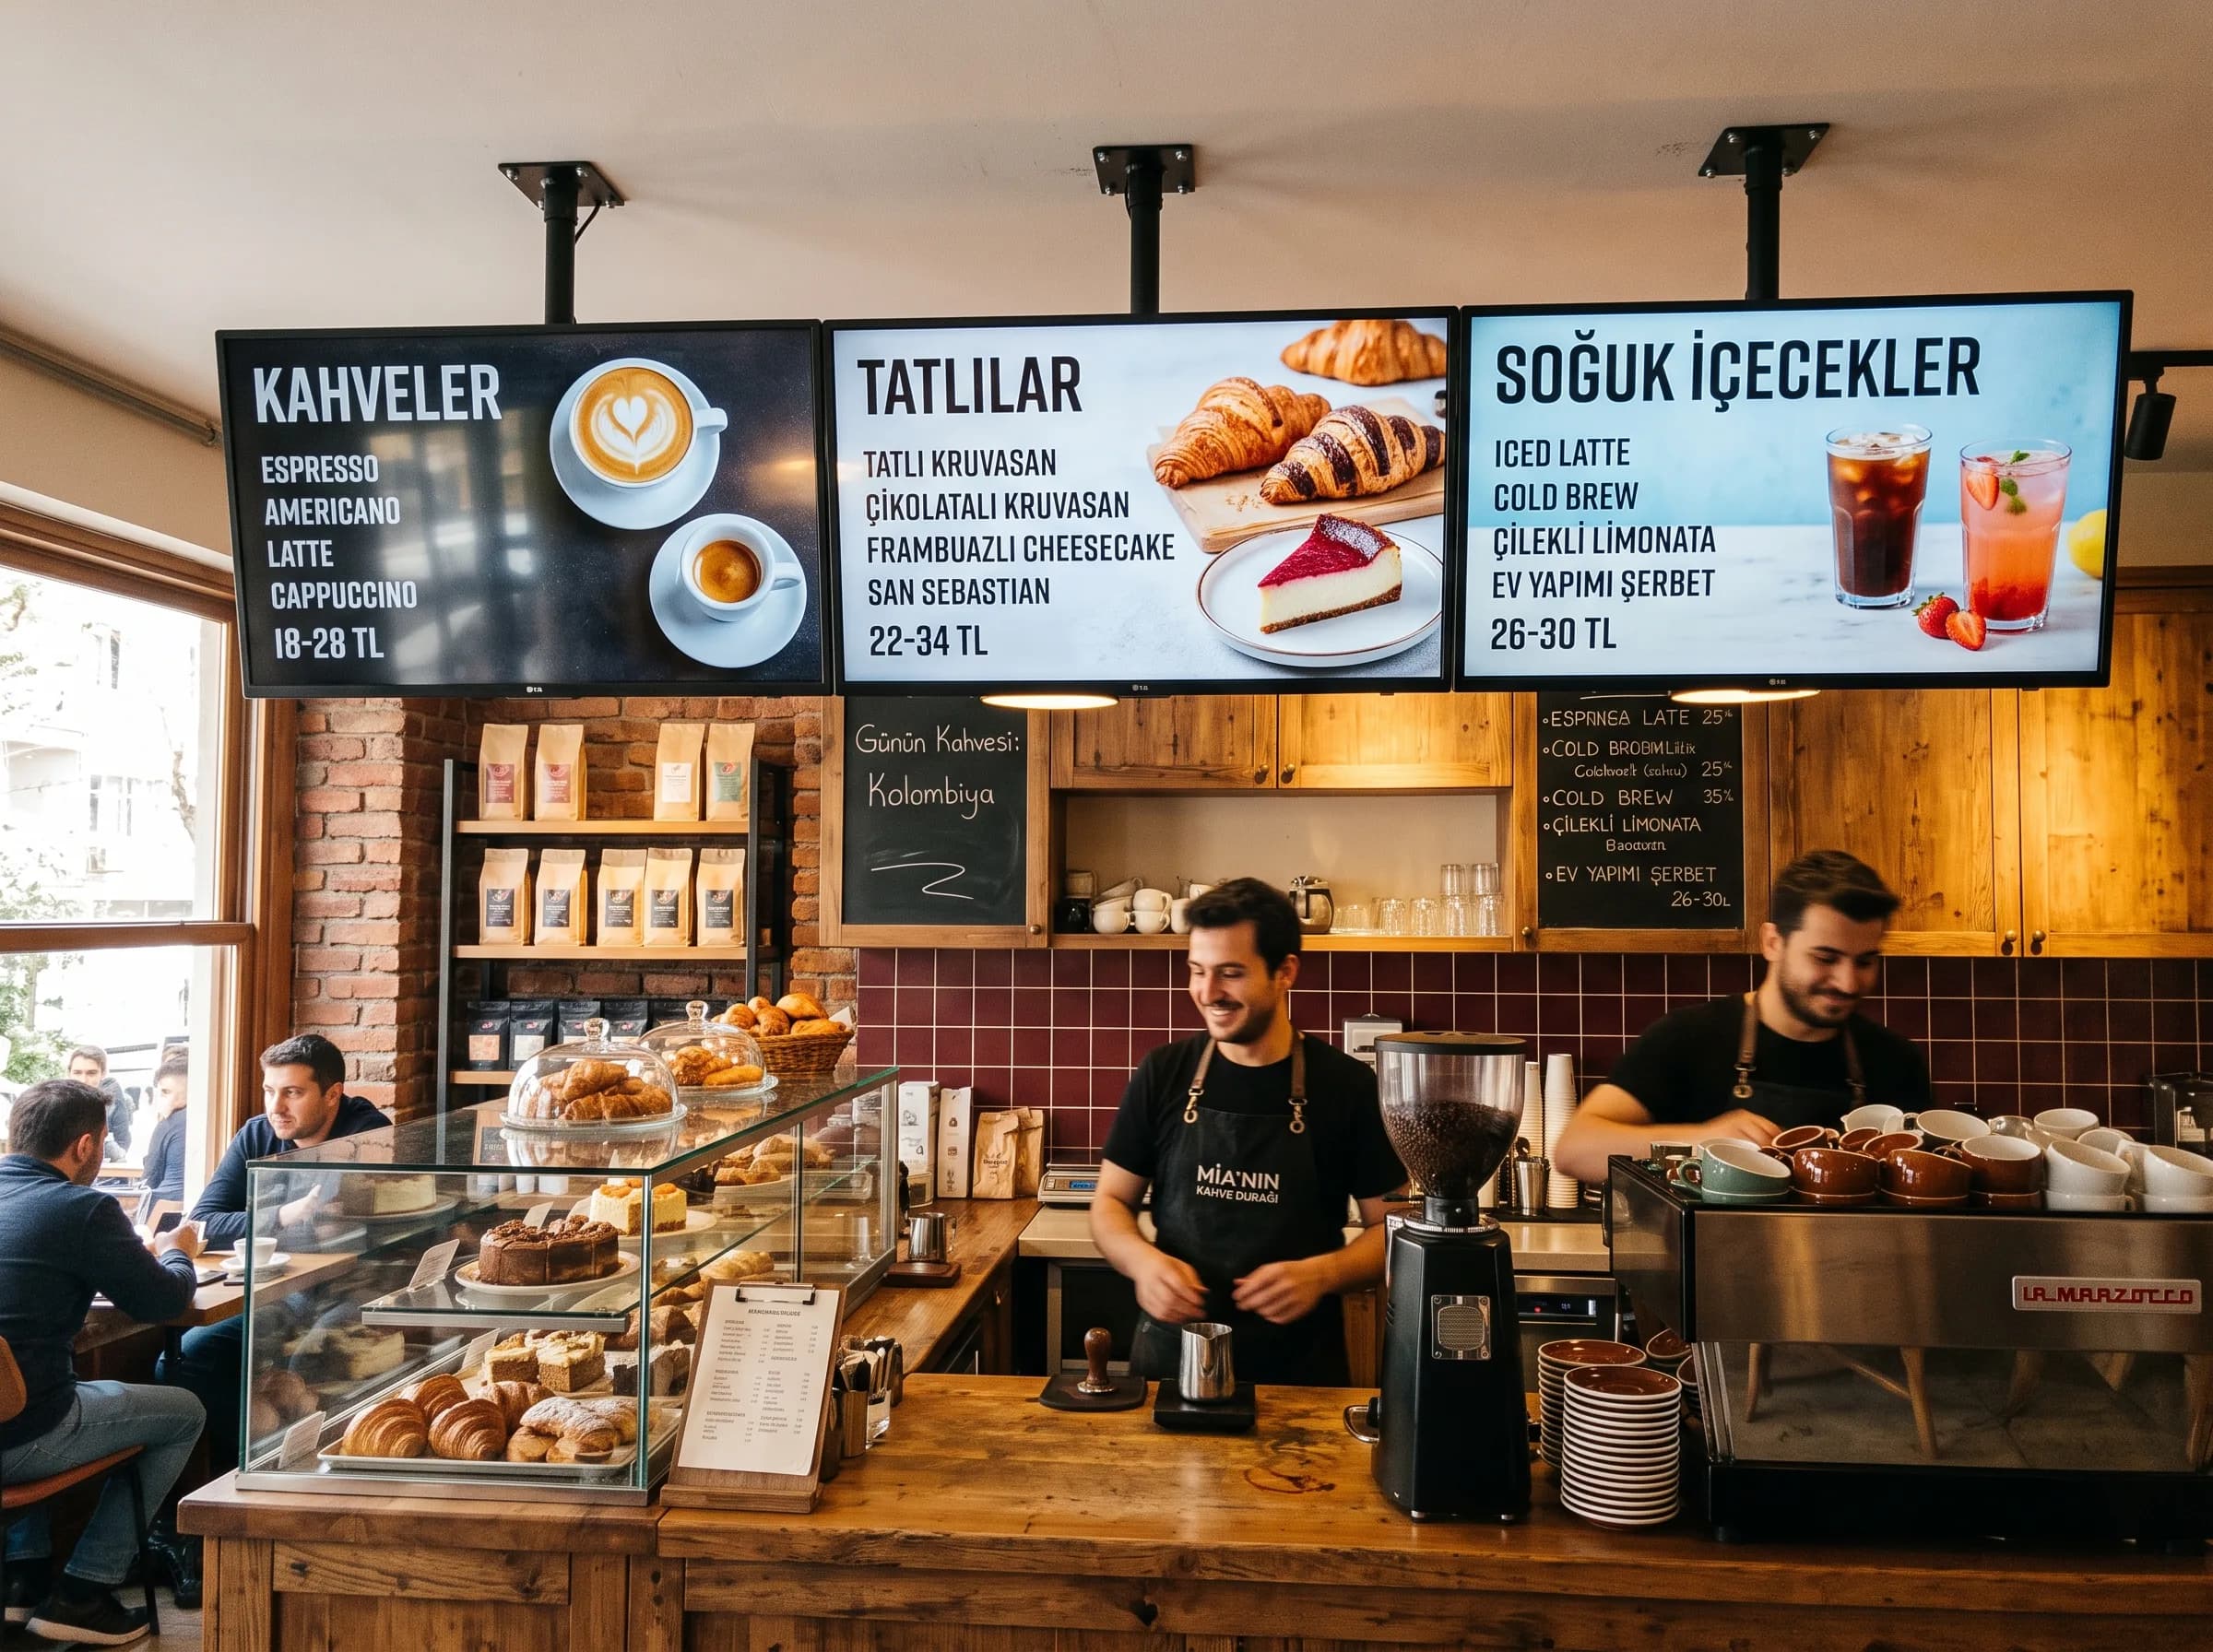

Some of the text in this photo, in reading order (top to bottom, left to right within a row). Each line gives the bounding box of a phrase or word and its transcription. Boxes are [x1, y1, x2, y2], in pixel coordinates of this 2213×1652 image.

[1497, 329, 1980, 412] SOĞUK İÇECEKLER
[254, 364, 503, 423] KAHVELER
[858, 357, 1082, 415] TATLILAR
[863, 449, 1055, 478] TATLI KRUVASAN
[1496, 439, 1629, 467] ICED LATTE
[261, 454, 378, 484] ESPRESSO
[265, 496, 400, 525] AMERICANO
[867, 489, 1129, 526] ÇİKOLATALI KRUVASAN
[1495, 482, 1638, 511] COLD BREW
[268, 539, 334, 568] LATTE
[868, 534, 1174, 562] FRAMBUAZLI CHEESECAKE
[1495, 521, 1715, 560] ÇİLEKLİ LİMONATA
[271, 580, 417, 609] CAPPUCCINO
[869, 578, 1049, 606] SAN SEBASTIAN
[1493, 570, 1715, 602] EV YAPIMI ŞERBET
[275, 628, 384, 659] 18-28 TL
[870, 625, 988, 655] 22-34 TL
[1492, 618, 1616, 649] 26-30 TL
[1644, 710, 1689, 725] LATE
[856, 725, 1020, 753] Günün Kahvesi:
[1552, 740, 1599, 756] COLD
[870, 773, 995, 820] Kolombiya
[1553, 790, 1604, 805] COLD
[1619, 790, 1674, 805] BREW
[1553, 814, 1701, 836] ÇİLEKLİ LİMONATA
[1557, 867, 1717, 886] EV YAPIMI ŞERBET
[1197, 1163, 1279, 1190] MİA'NIN
[1196, 1185, 1278, 1203] KAHVE DURAĞI
